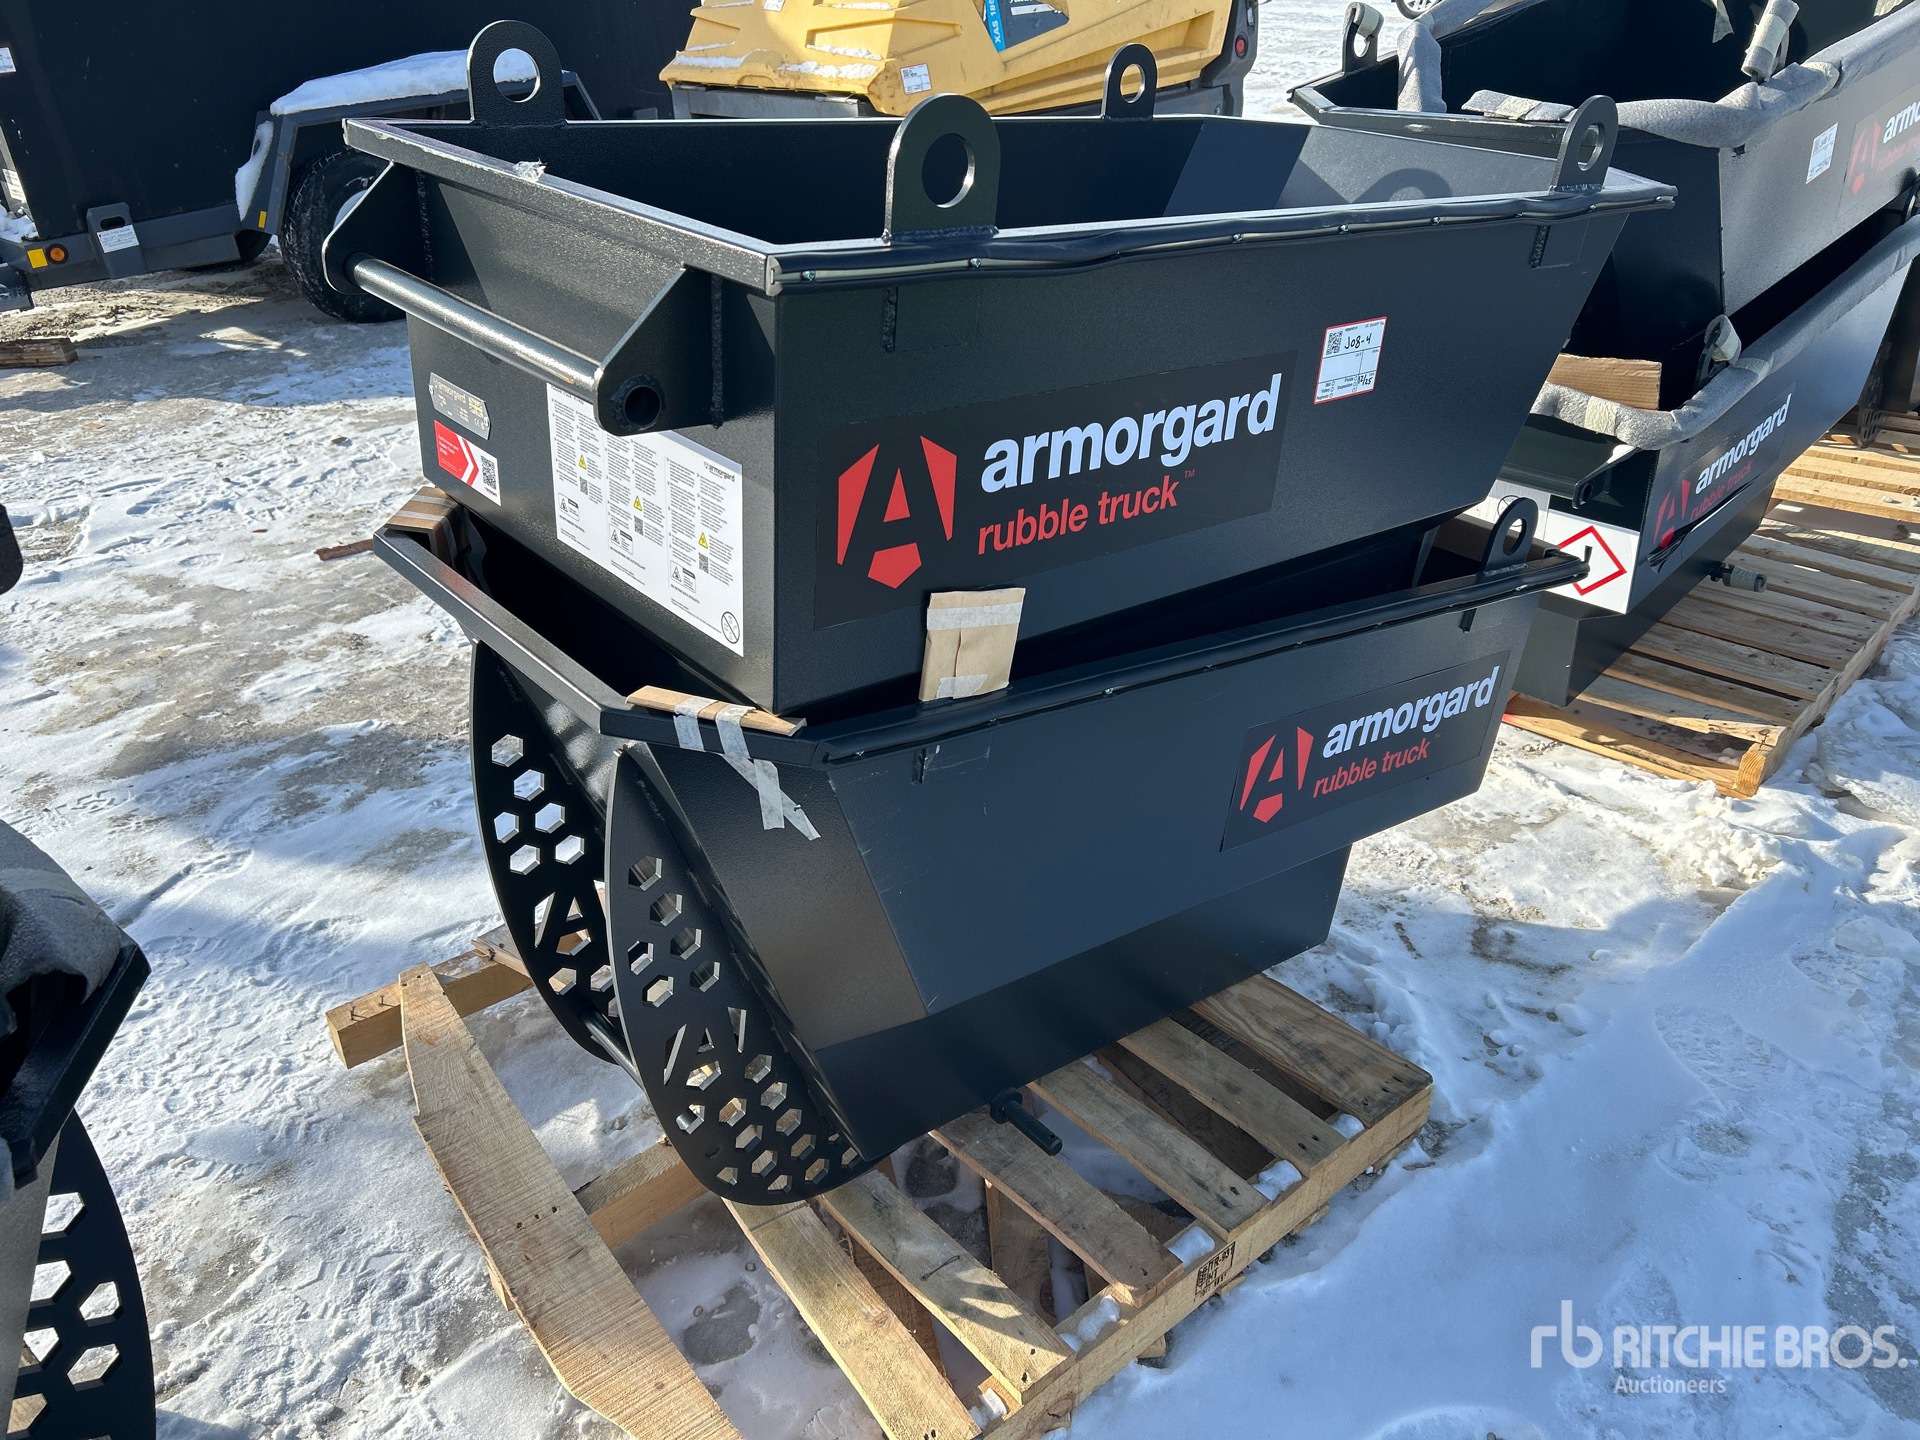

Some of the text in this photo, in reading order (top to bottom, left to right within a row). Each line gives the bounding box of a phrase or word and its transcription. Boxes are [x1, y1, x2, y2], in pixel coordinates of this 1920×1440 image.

[991, 20, 1002, 44] XAS
[980, 372, 1283, 493] armorgard
[1695, 393, 1792, 494] armorgard
[977, 500, 1089, 556] rubble
[1097, 475, 1180, 526] truck
[1689, 459, 1754, 523] rubble truck
[1322, 665, 1500, 759] armorgard
[1312, 736, 1431, 799] rubble truck
